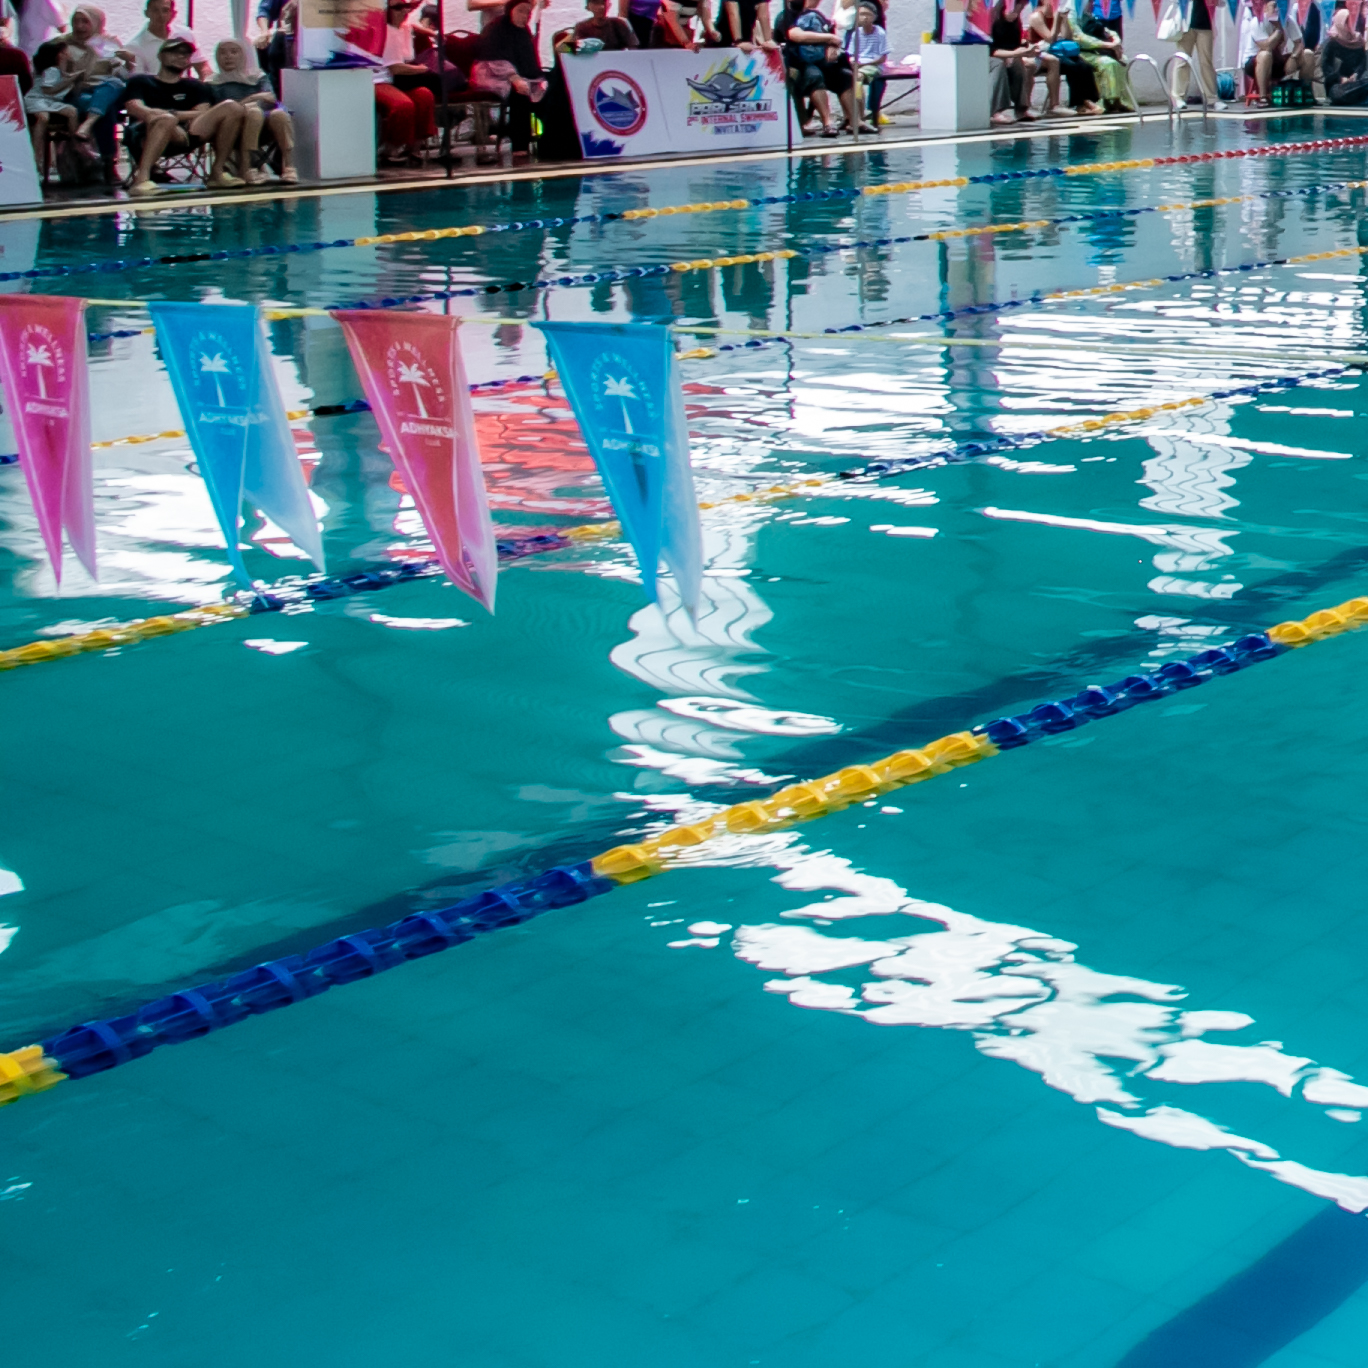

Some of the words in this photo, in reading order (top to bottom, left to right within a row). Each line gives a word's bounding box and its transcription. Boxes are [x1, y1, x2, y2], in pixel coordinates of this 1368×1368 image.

[701, 114, 737, 125] INTERNAL
[740, 112, 778, 123] SWIMMING
[400, 422, 459, 439] ADHYAKSA
